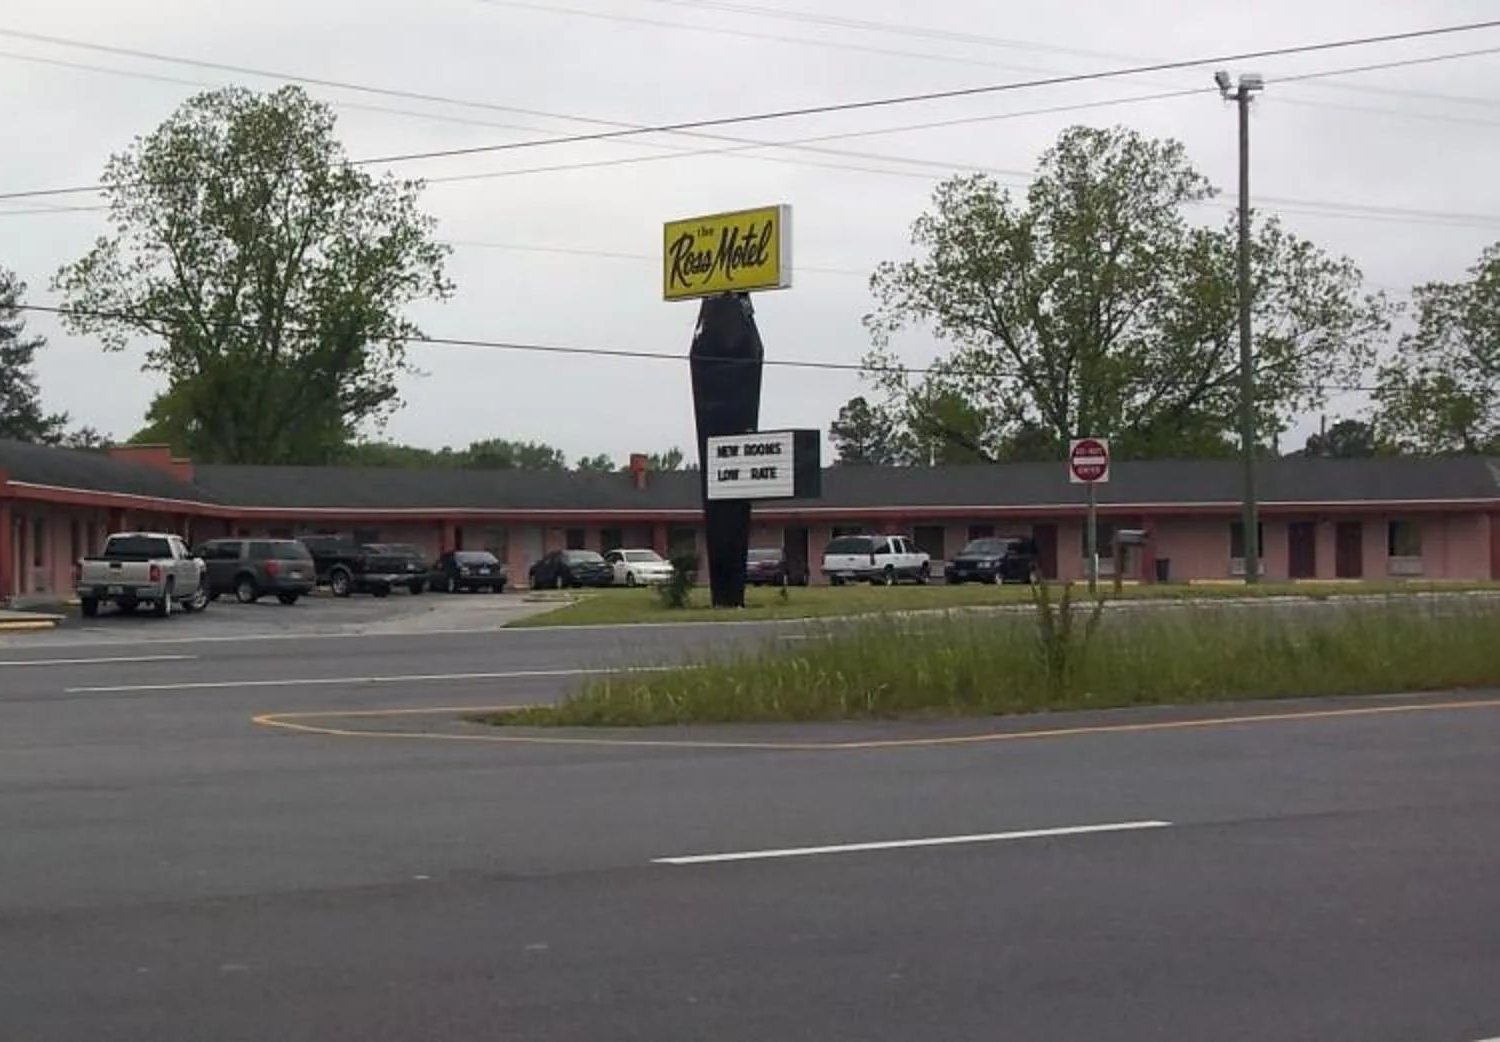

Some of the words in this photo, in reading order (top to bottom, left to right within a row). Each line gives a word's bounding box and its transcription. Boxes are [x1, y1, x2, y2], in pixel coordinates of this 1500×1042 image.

[669, 231, 711, 288] Ross
[703, 219, 773, 284] Motel
[717, 469, 739, 481] LOW
[750, 467, 777, 480] RATE
